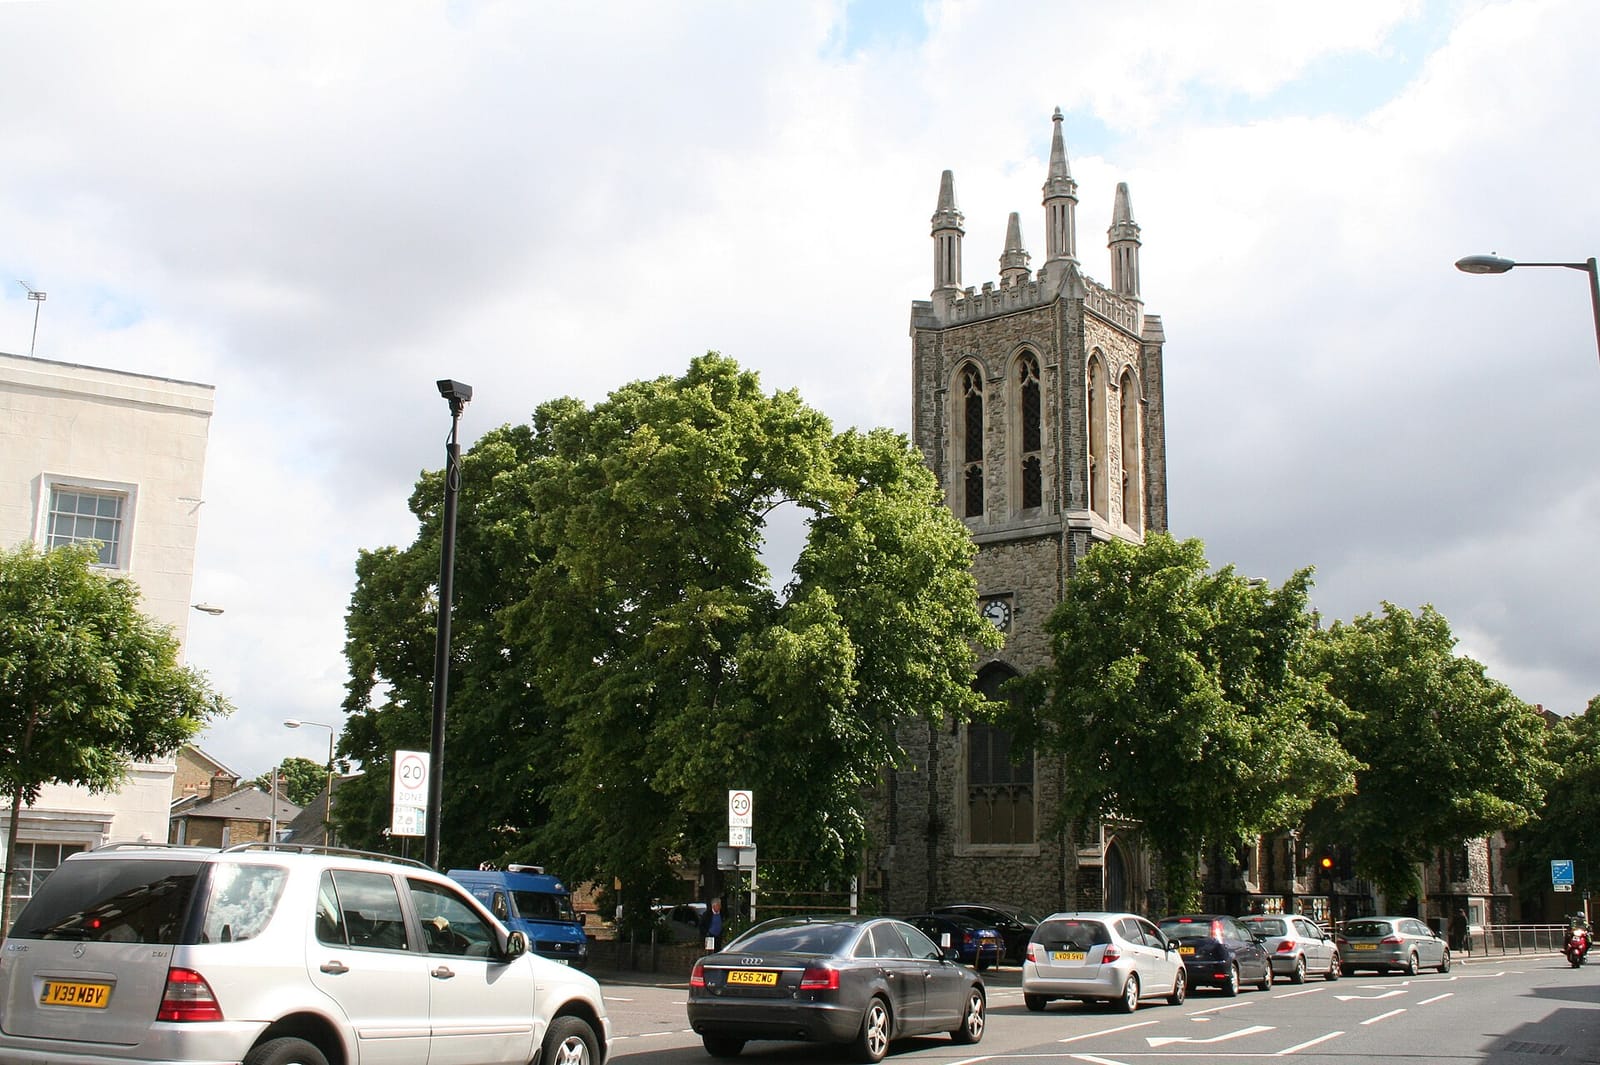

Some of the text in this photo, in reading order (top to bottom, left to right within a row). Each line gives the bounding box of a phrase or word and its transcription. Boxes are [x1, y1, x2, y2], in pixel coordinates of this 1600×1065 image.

[402, 765, 422, 780] 20
[399, 792, 422, 802] ZONE
[734, 800, 748, 810] 20
[732, 972, 754, 982] EX56
